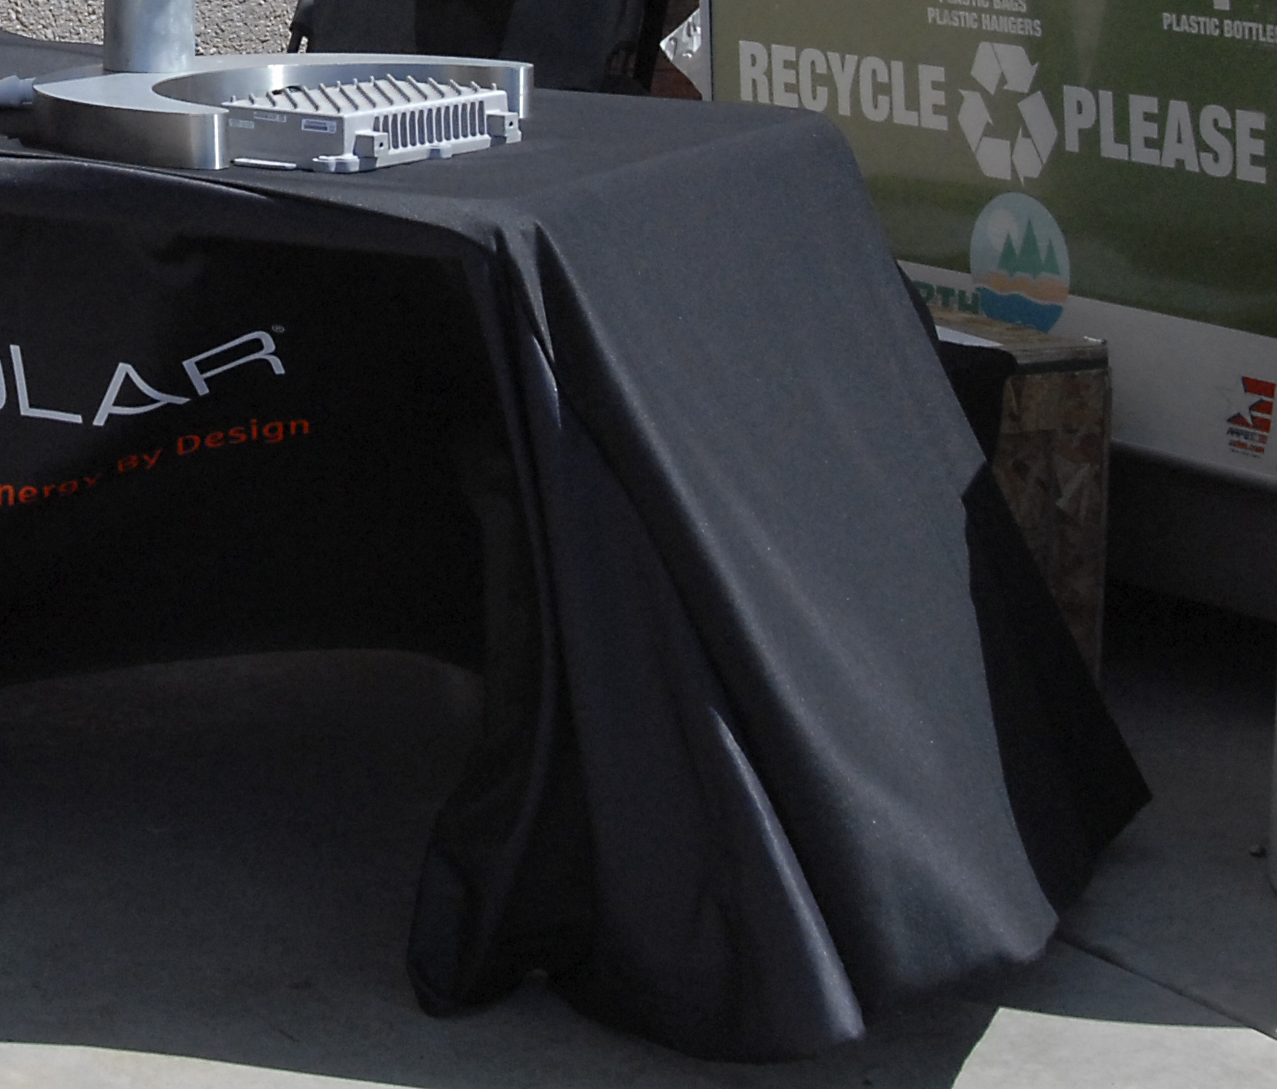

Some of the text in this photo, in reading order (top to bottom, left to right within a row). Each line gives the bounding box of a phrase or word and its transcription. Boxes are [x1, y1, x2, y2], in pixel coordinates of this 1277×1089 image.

[927, 7, 1042, 37] PLASTIC HANGERS
[1162, 12, 1220, 36] PLASTIC
[738, 40, 1267, 185] RECYCLE PLEASE
[177, 417, 311, 456] Design
